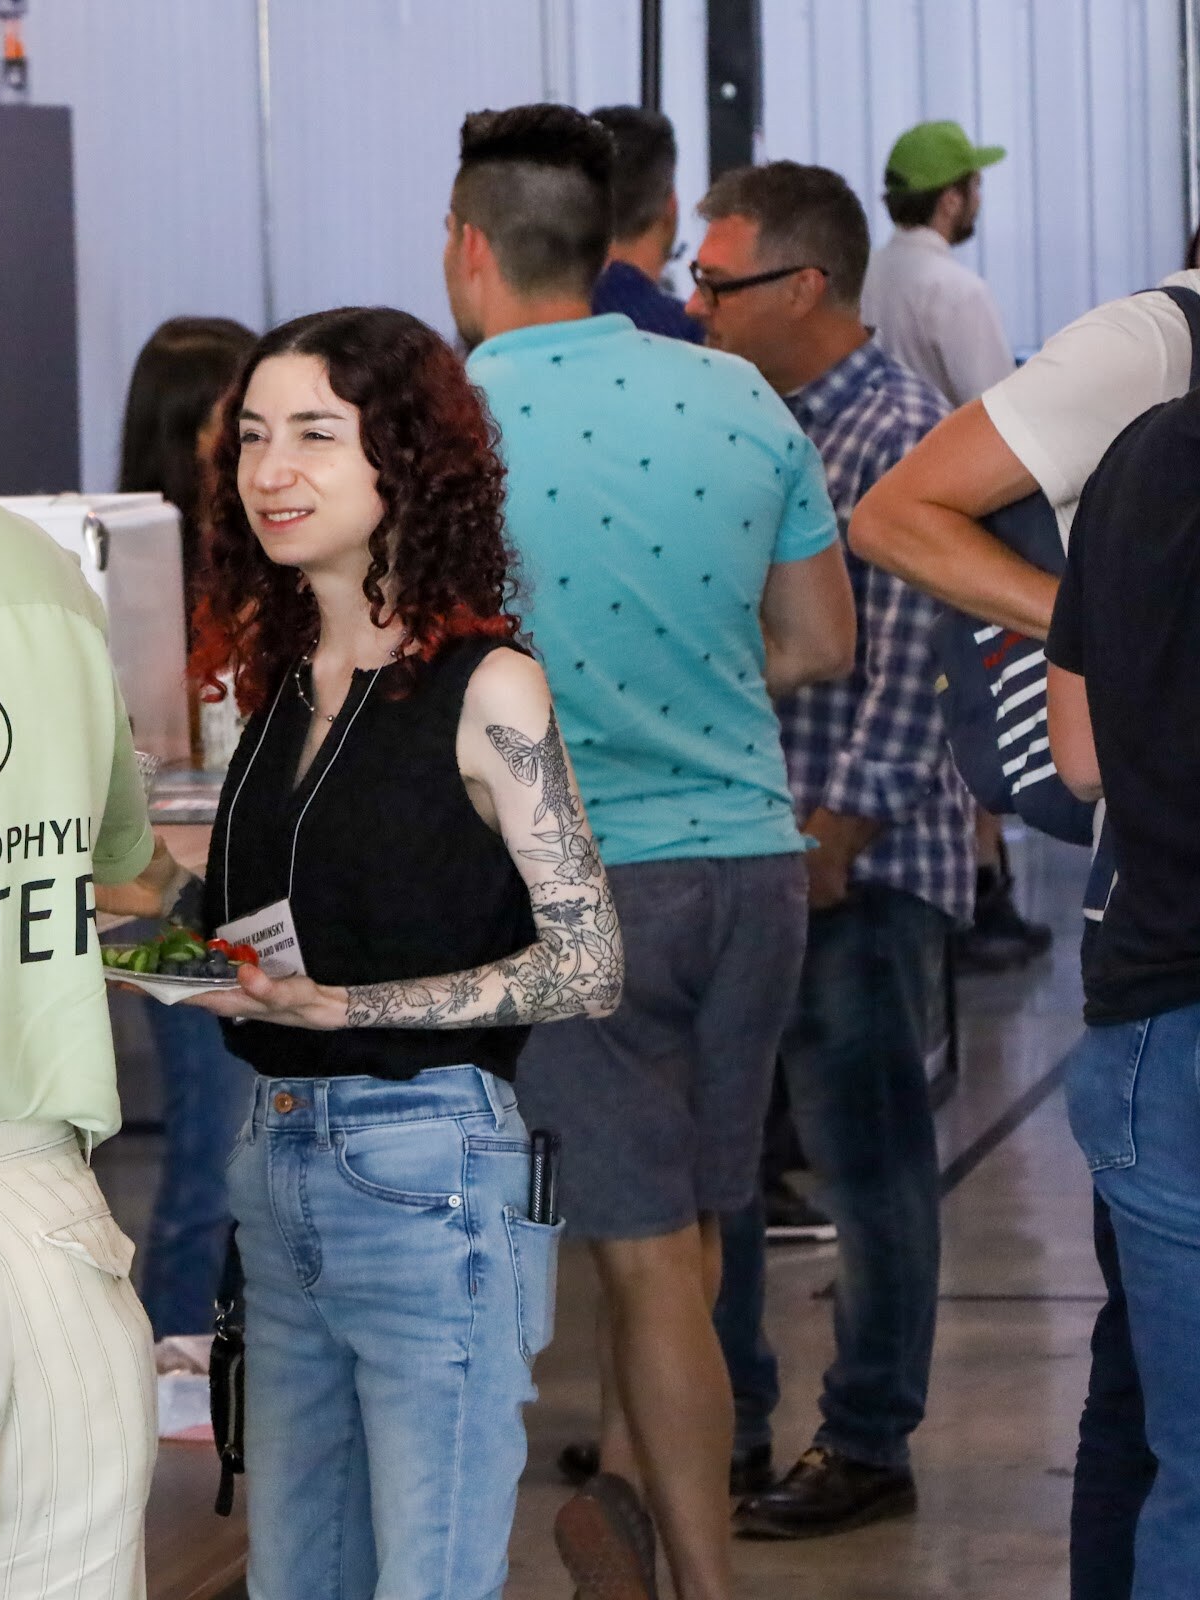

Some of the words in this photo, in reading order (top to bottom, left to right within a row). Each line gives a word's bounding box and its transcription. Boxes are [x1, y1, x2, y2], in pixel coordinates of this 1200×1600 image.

[251, 921, 285, 945] KAMINSKY
[263, 944, 275, 958] AND
[274, 937, 295, 953] WRITER
